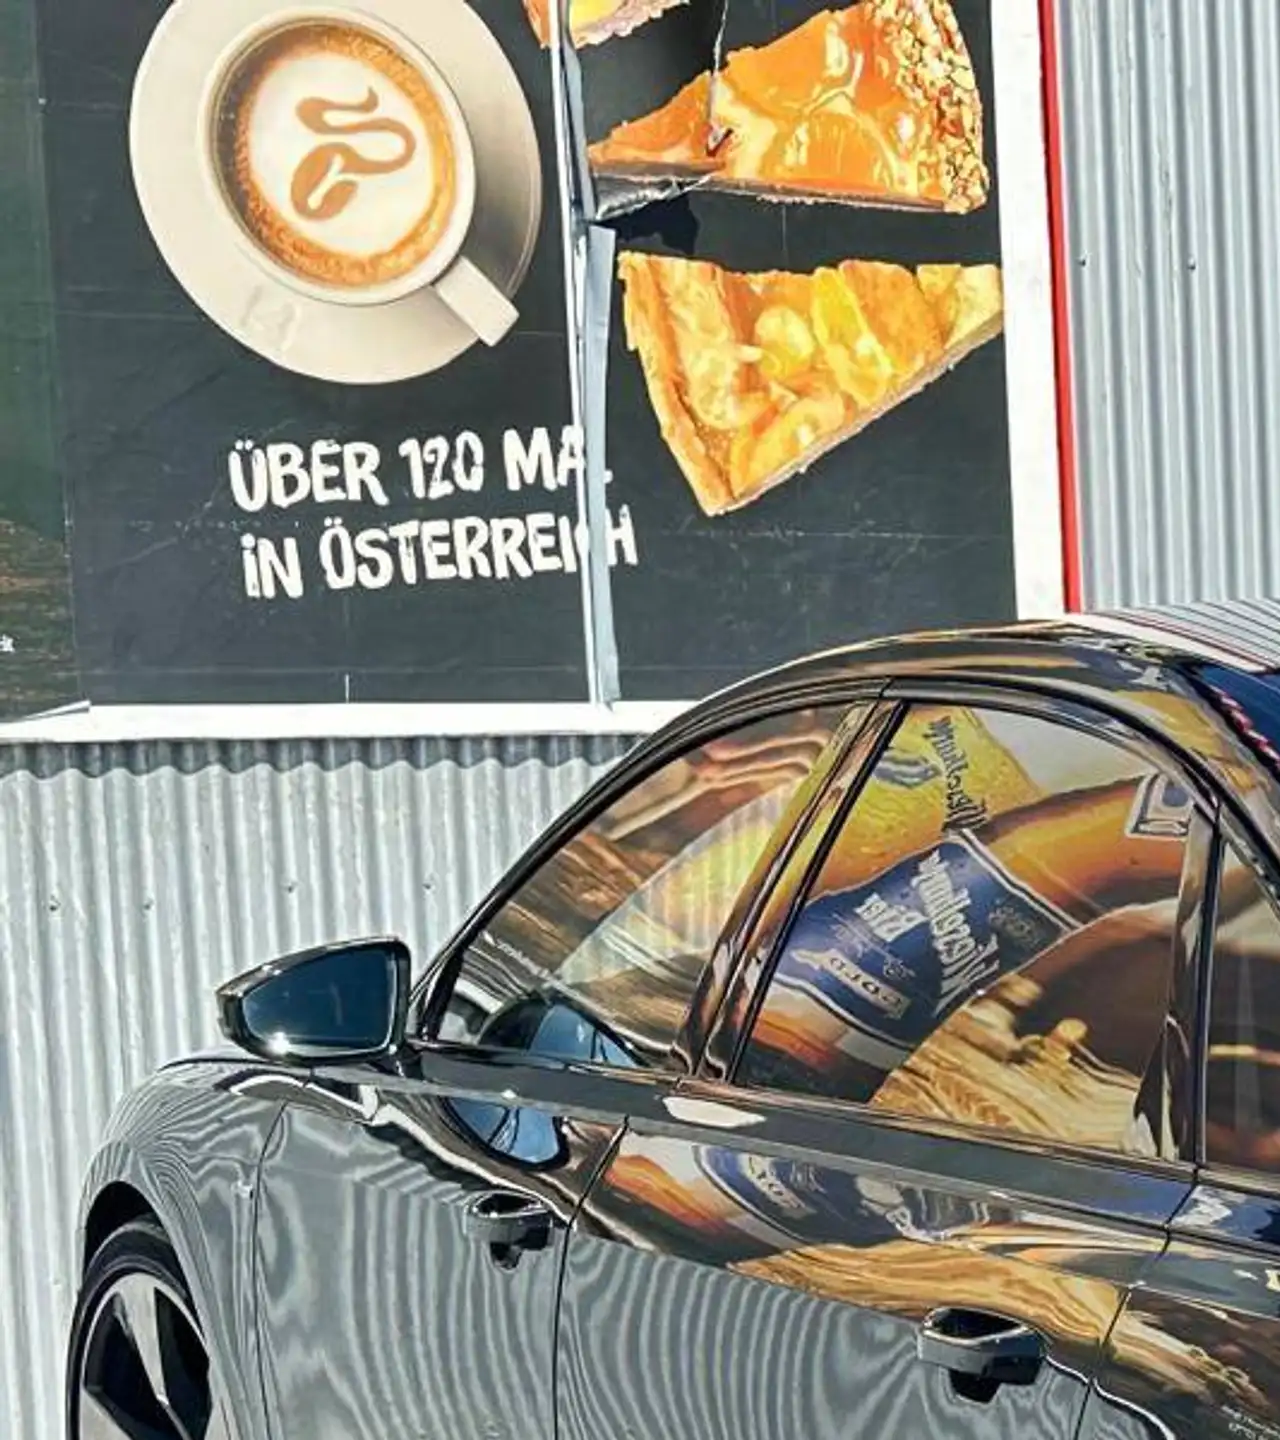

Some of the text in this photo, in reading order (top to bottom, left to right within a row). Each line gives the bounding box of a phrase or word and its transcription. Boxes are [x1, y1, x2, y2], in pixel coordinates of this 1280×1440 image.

[228, 425, 613, 512] ÜBER 120 MA
